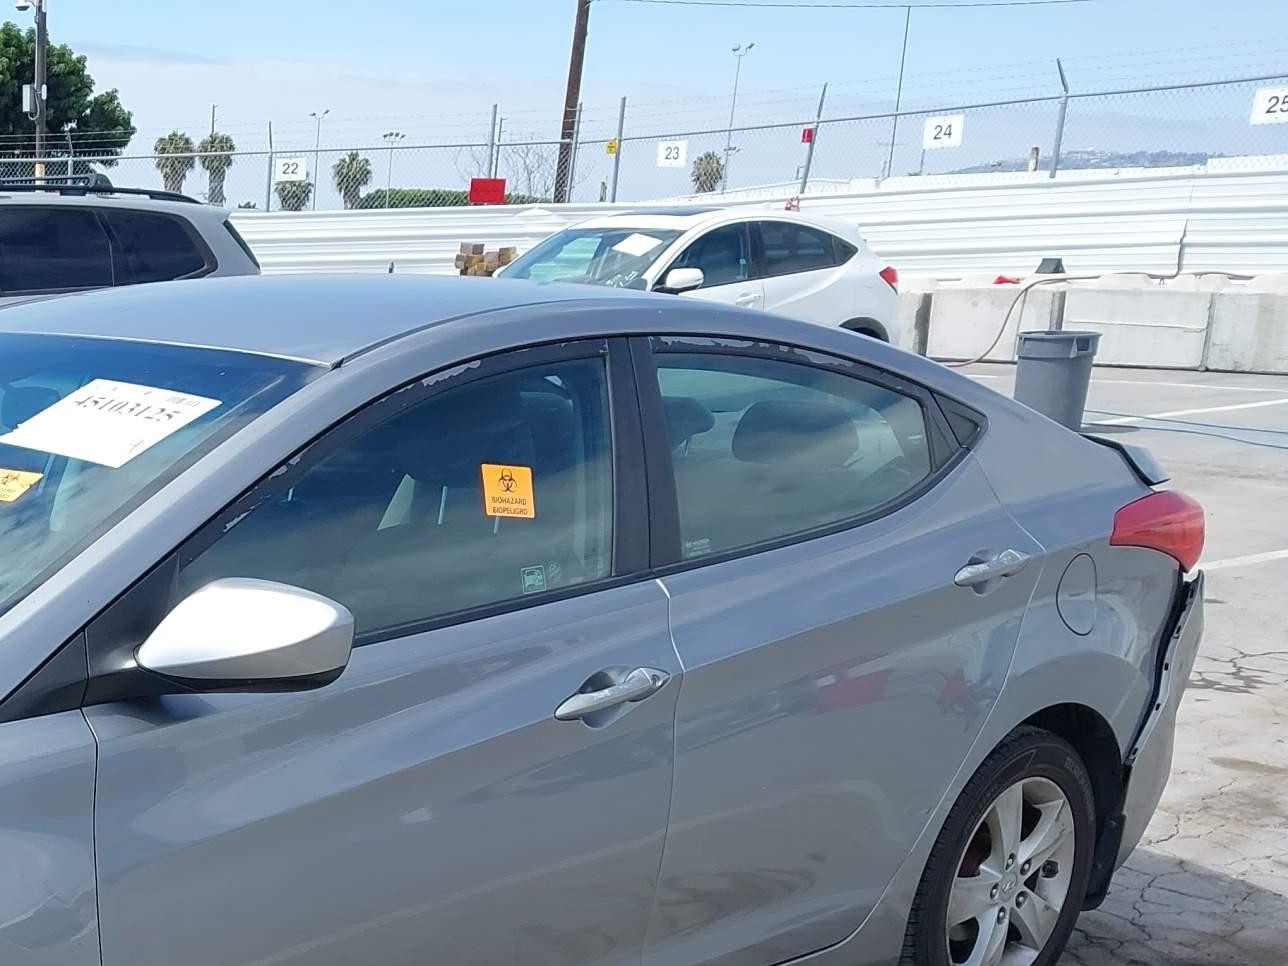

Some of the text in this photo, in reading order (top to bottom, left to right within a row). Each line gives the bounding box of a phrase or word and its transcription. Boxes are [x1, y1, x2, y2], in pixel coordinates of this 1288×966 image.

[1265, 95, 1288, 114] 25
[933, 124, 952, 140] 24
[664, 146, 680, 160] 23
[282, 162, 299, 175] 22
[73, 395, 181, 421] 45103125
[491, 496, 527, 506] BIOHAZARD
